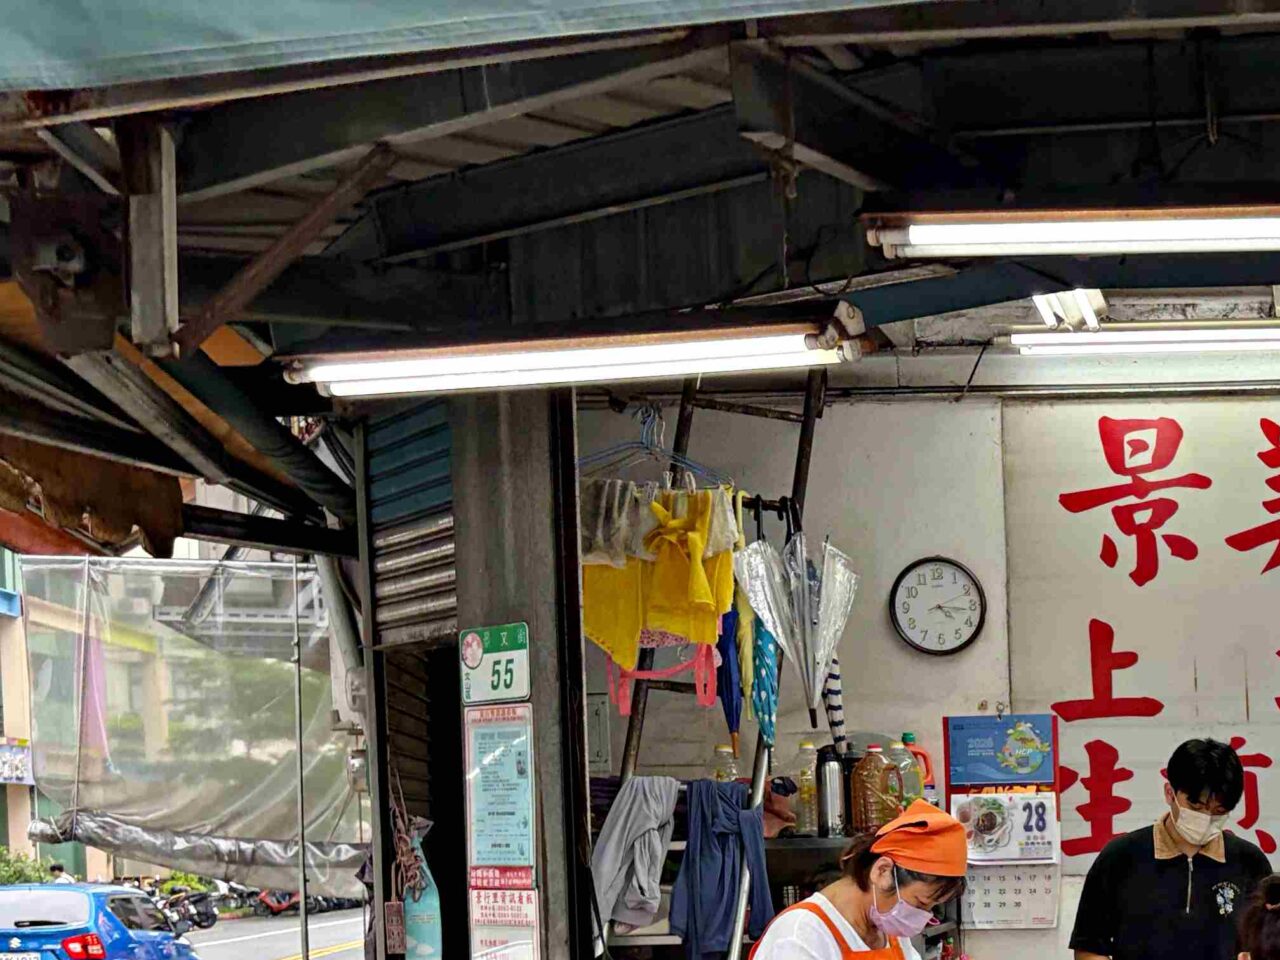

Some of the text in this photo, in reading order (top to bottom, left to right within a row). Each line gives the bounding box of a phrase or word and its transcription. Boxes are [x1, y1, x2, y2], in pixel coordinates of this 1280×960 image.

[917, 573, 927, 586] 11
[929, 567, 944, 580] 12
[952, 571, 957, 585] 1
[905, 586, 918, 599] 10
[963, 583, 971, 596] 2
[902, 600, 910, 614] 9
[968, 599, 977, 612] 3
[908, 617, 916, 630] 8
[964, 615, 973, 628] 4
[920, 629, 928, 642] 7
[938, 633, 945, 646] 6
[954, 627, 962, 640] 5
[491, 658, 514, 691] 55
[1022, 801, 1047, 833] 28
